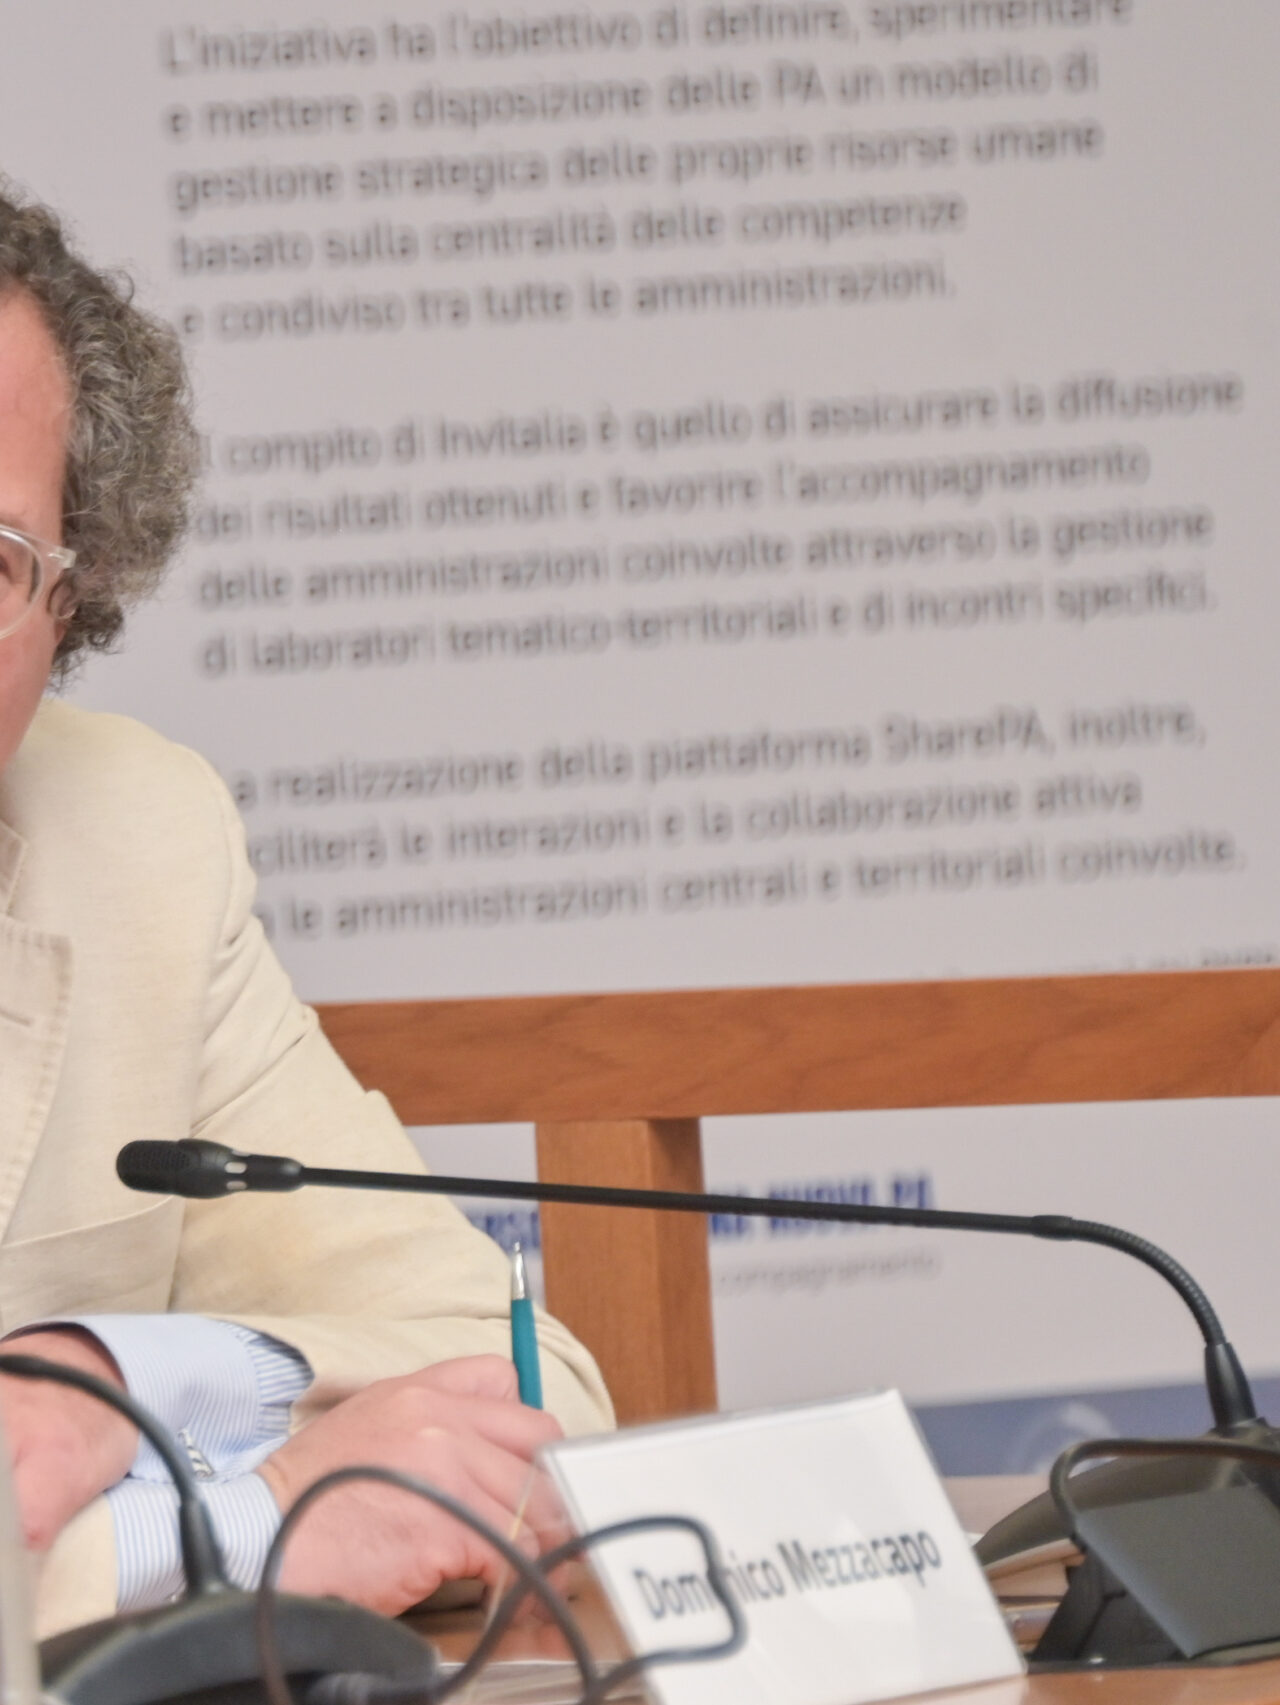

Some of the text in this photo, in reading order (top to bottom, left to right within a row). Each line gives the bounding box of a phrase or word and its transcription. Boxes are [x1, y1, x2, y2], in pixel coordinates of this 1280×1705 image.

[386, 23, 432, 58] ha
[447, 15, 639, 55] l'obiettivo
[651, 6, 688, 46] di
[699, 2, 859, 45] definire,
[166, 107, 188, 139] e
[203, 98, 360, 134] mettere
[375, 96, 395, 128] a
[664, 70, 757, 111] delle
[772, 64, 822, 102] PA
[835, 69, 880, 102] un
[894, 54, 1051, 97] modello
[1061, 49, 1098, 90] di
[171, 122, 1100, 211] gestione strategica delle proprie risorse umane
[175, 196, 963, 273] basato sulla centralità delle competenze
[181, 308, 201, 337] e
[216, 293, 402, 338] condiviso
[414, 292, 467, 325] tra
[480, 285, 570, 321] tutte
[584, 279, 618, 314] le
[226, 428, 381, 473] compito
[391, 421, 425, 462] di
[436, 412, 586, 457] Invitalia
[630, 402, 751, 451] quello
[761, 397, 796, 438] di
[807, 392, 996, 435] assicurare
[1010, 385, 1041, 421] la
[1054, 376, 1240, 419] diffusione
[199, 505, 252, 540] dei
[262, 493, 413, 535] risultati
[421, 482, 568, 526] ottenuti
[576, 484, 597, 515] e
[610, 473, 760, 513] favorire
[196, 565, 289, 608] delle
[618, 533, 790, 580] coinvolte
[805, 524, 994, 568] attraverso
[1005, 517, 1037, 554] la
[1050, 509, 1210, 561] gestione
[199, 634, 237, 676] di
[247, 627, 436, 671] laboratori
[826, 601, 848, 632] e
[860, 590, 895, 631] di
[905, 585, 1044, 625] incontri
[236, 773, 257, 810] a
[535, 742, 630, 785] della
[645, 730, 868, 784] piattaforma
[883, 710, 1055, 760] SharePA,
[1067, 705, 1205, 744] inoltre,
[248, 826, 384, 874] ciliterà
[397, 825, 429, 861] le
[446, 811, 651, 857] interazioni
[661, 811, 681, 842] e
[696, 804, 730, 839] la
[1034, 776, 1138, 815] attiva
[287, 896, 319, 938] le
[660, 860, 808, 909] centrali
[818, 865, 838, 897] e
[633, 1530, 941, 1620] Domnico Mezzacapo
